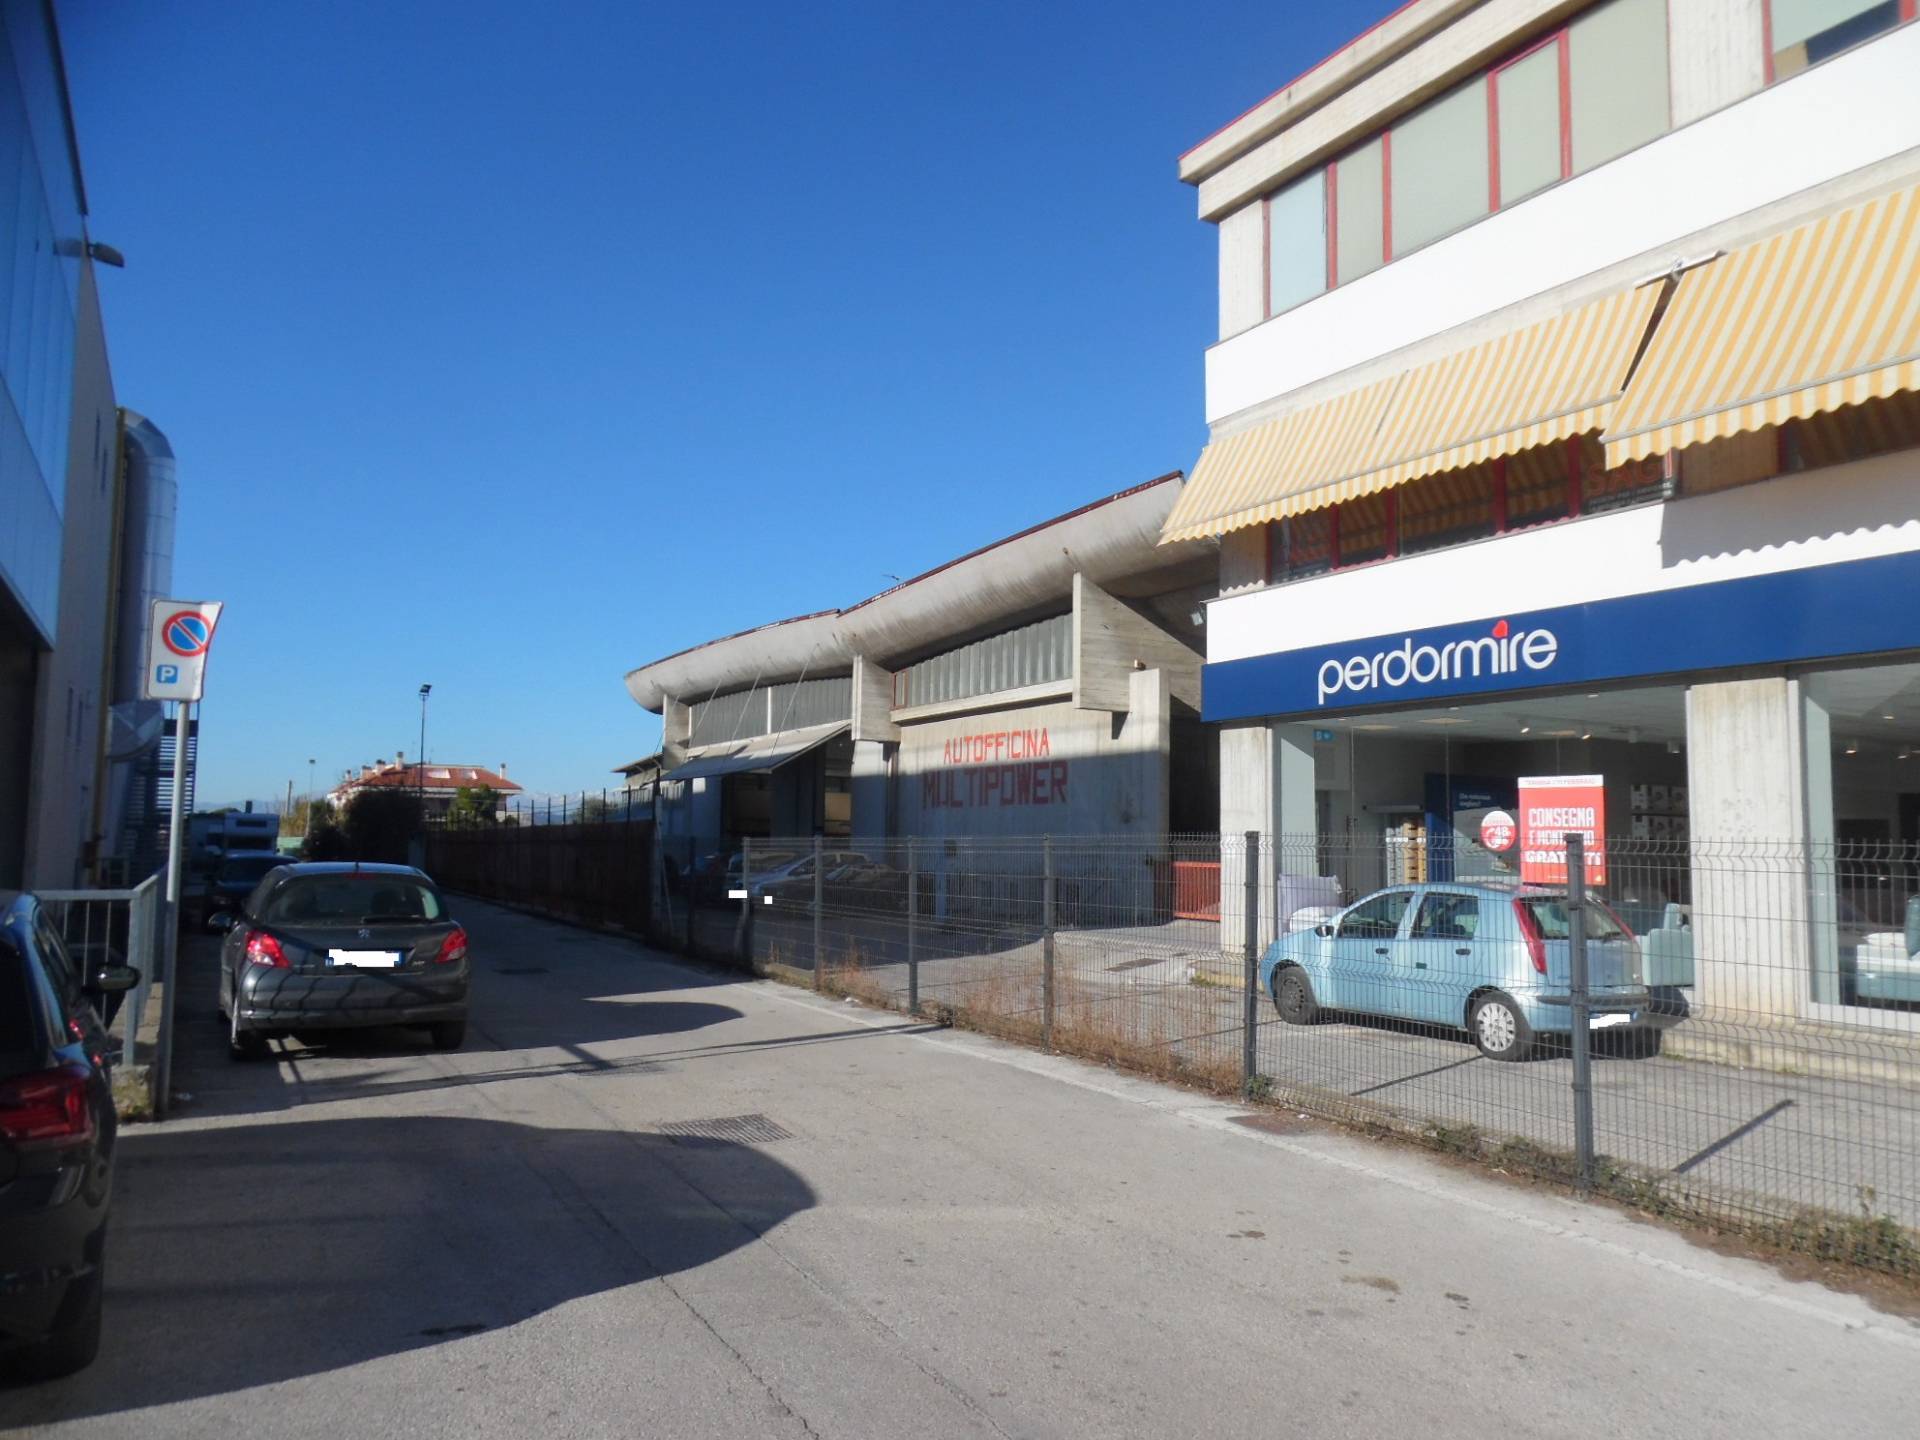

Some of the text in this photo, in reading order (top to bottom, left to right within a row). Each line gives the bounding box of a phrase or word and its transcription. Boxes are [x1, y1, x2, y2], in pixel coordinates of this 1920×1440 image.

[1317, 620, 1559, 705] perdormire
[161, 667, 174, 682] P
[943, 727, 1050, 764] AUTOFFICINA
[922, 760, 1069, 810] MULTIPOWER
[1528, 806, 1595, 828] CONSEGNA
[1528, 830, 1536, 846] E
[1536, 829, 1595, 846] MONTIO
[1525, 850, 1600, 865] GRATTI
